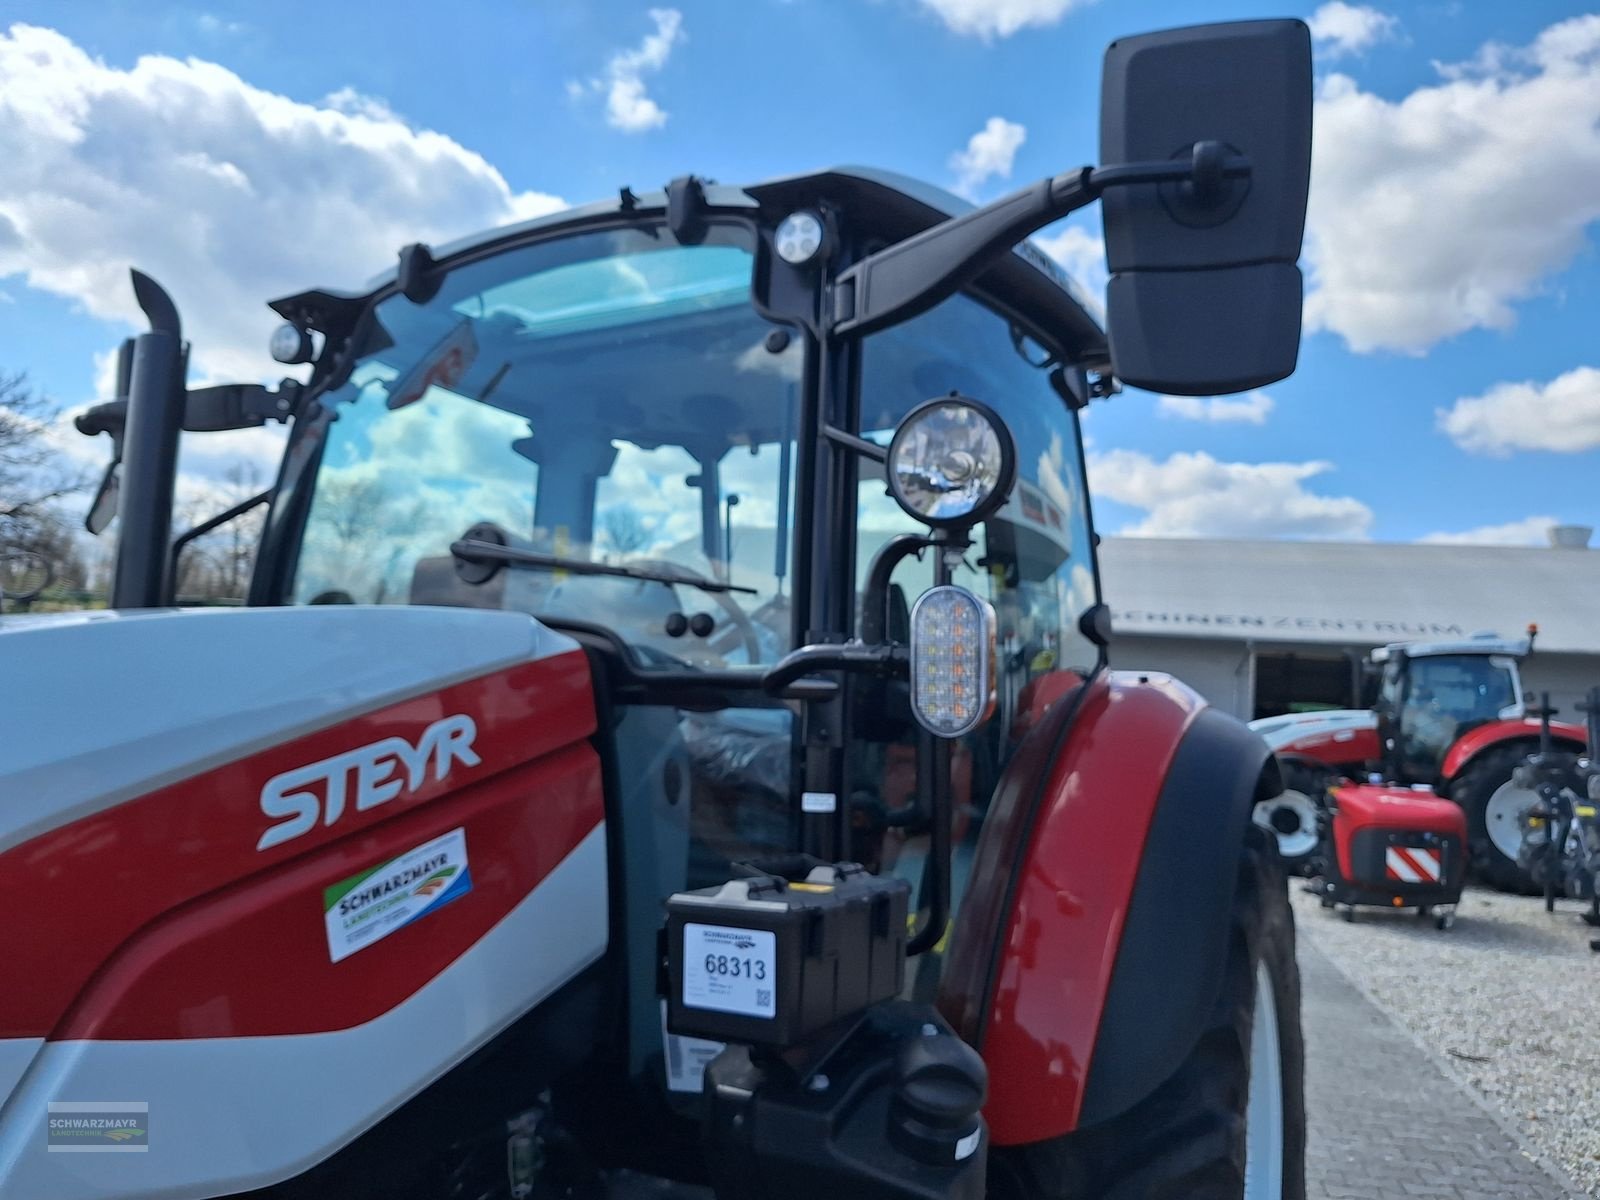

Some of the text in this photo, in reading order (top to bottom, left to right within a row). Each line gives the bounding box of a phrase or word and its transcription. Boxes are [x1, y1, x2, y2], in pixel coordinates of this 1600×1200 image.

[256, 713, 482, 852] STEYR
[339, 852, 448, 916] SCHWARZMAYR
[705, 953, 766, 980] 68313
